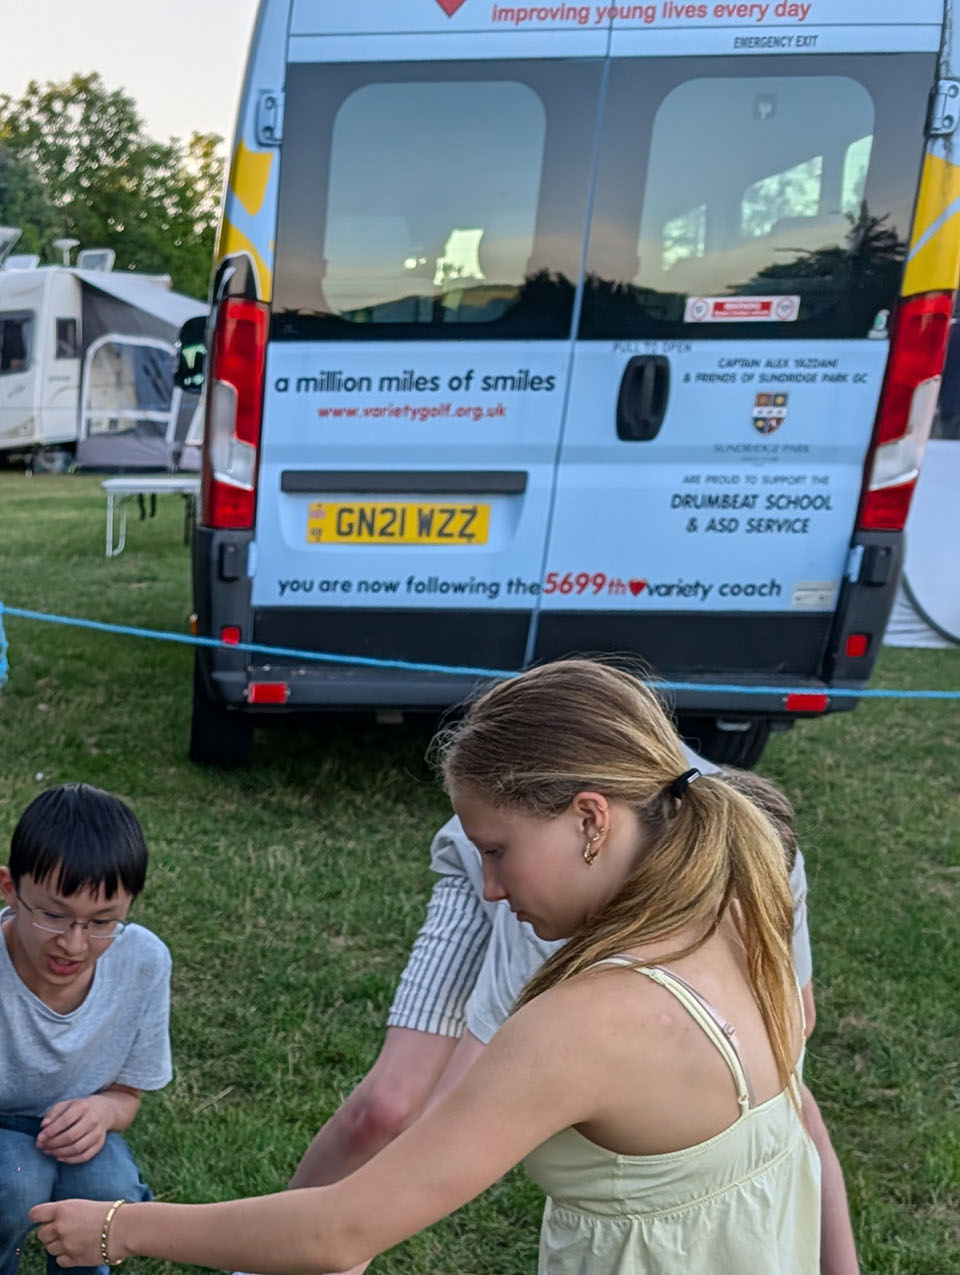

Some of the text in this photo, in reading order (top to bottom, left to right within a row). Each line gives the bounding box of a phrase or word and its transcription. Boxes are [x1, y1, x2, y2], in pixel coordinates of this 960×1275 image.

[491, 0, 811, 26] improving young lives every day
[733, 35, 818, 49] EMERGENCY EXIT
[718, 358, 760, 369] CAPTAIN
[274, 369, 557, 393] a million miles of smiles
[694, 373, 738, 384] FRIENDS
[742, 373, 756, 384] OF
[759, 373, 818, 384] SUNDRIDGE
[821, 373, 848, 384] PARK
[317, 403, 507, 421] www.varietygolf.org.uk
[682, 474, 830, 485] ARE PROUD TO SUPPORT THE
[670, 493, 833, 511] DRUMBEAT SCHOOL
[336, 507, 479, 539] GN21 WZZ
[686, 517, 811, 534] & ASD SERVICE
[277, 578, 315, 597] you
[318, 578, 353, 594] are
[356, 578, 400, 594] now
[405, 575, 501, 599] following
[505, 577, 541, 595] the
[646, 578, 713, 601] variety
[718, 578, 783, 597] coach
